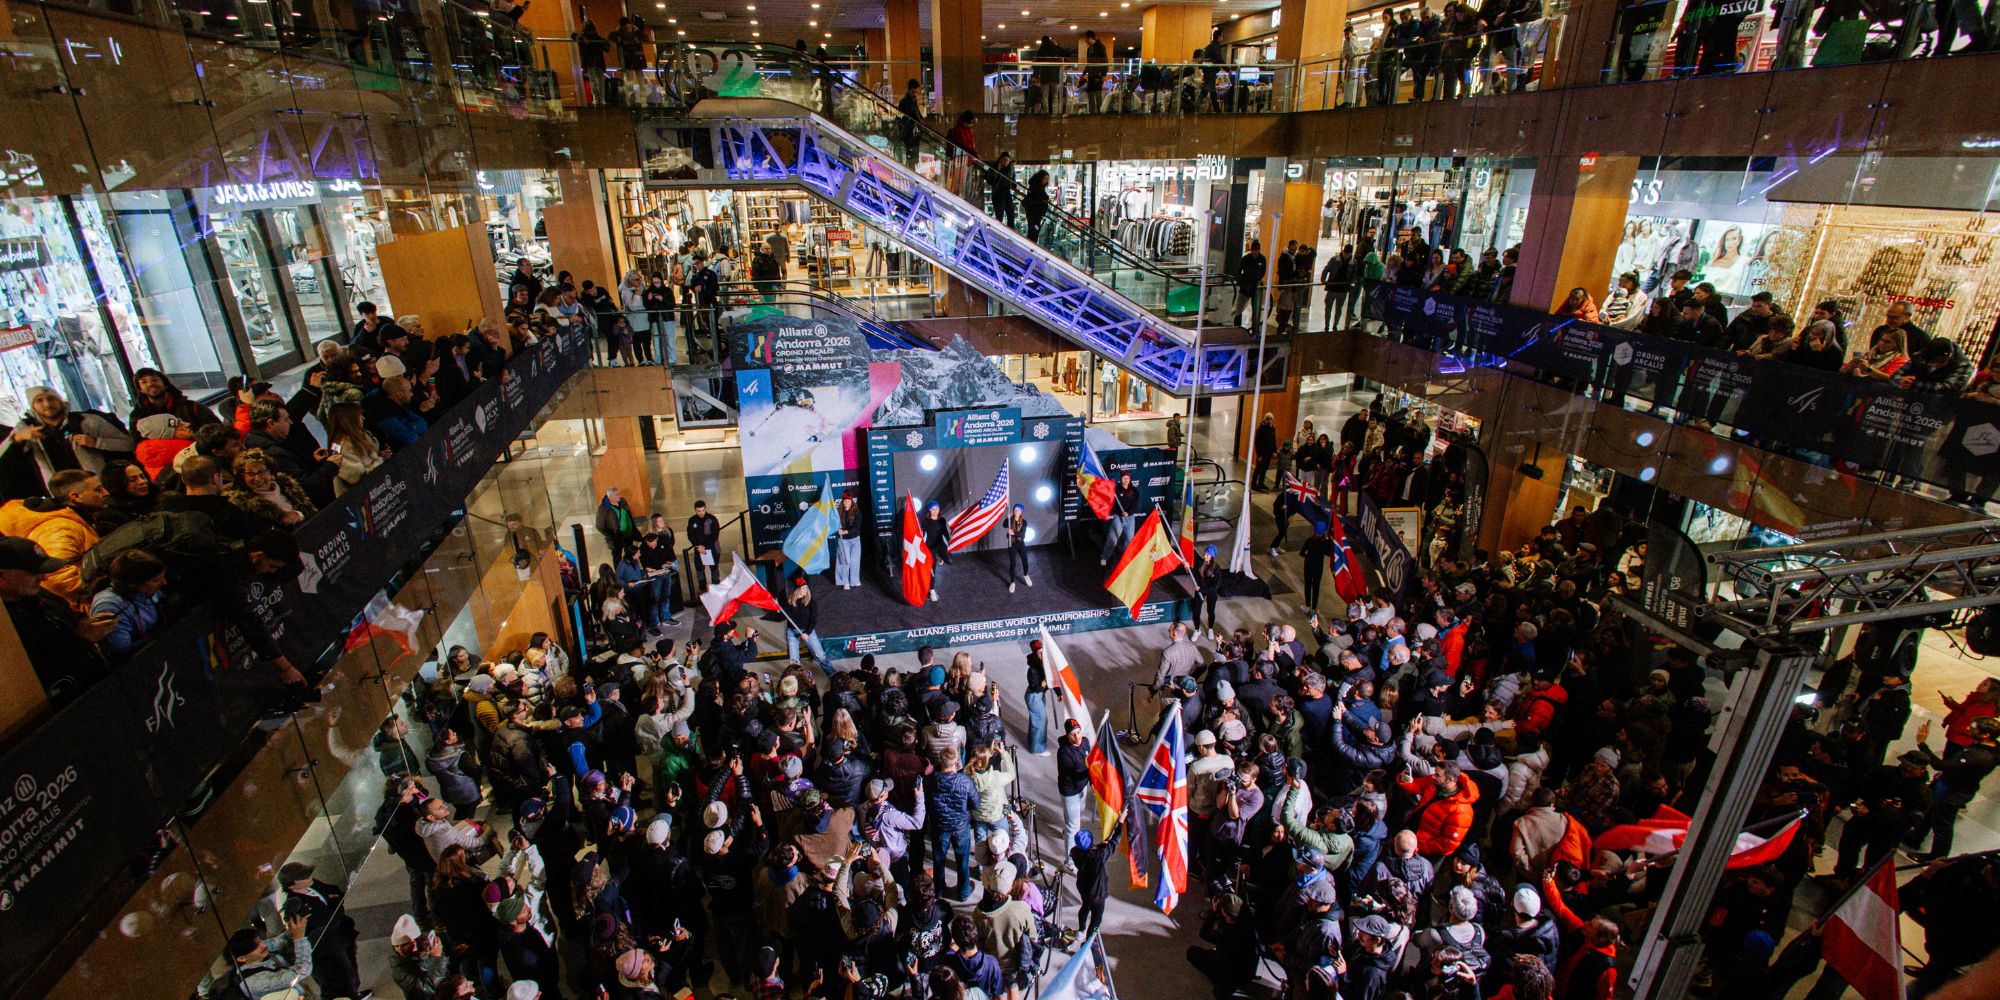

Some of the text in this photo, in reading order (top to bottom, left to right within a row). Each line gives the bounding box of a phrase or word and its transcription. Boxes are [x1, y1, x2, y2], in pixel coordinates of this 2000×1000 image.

[1183, 165, 1227, 181] RAW
[213, 181, 315, 204] JACK&JONES
[1888, 294, 1955, 310] REBAIXES
[778, 327, 813, 337] Allianz
[1568, 328, 1585, 337] Allianz
[775, 337, 851, 349] Andorra 2026
[1564, 335, 1604, 349] Andorra 2026
[776, 349, 804, 357] ORDINO
[1636, 351, 1666, 363] ORDINO
[796, 362, 843, 371] MAMMUT
[1704, 357, 1728, 369] Allianz
[1732, 373, 1753, 384] 2026
[1874, 396, 1909, 411] Allianz
[964, 419, 1014, 429] Andorra 2026
[967, 413, 990, 421] Allianz
[1913, 415, 1943, 429] 2026
[318, 530, 347, 560] ORDINO
[321, 541, 350, 573] ARCALÍS
[907, 609, 1110, 639] ALLIANZ FIS FREERIDE WORLD CHAMPIONSHIPS
[949, 632, 994, 644] ANDORRA
[995, 629, 1016, 638] 2026
[1017, 628, 1029, 636] BY
[36, 765, 78, 811] 2026
[18, 804, 62, 851] ARCALÍS
[14, 817, 85, 892] MAMMUT
